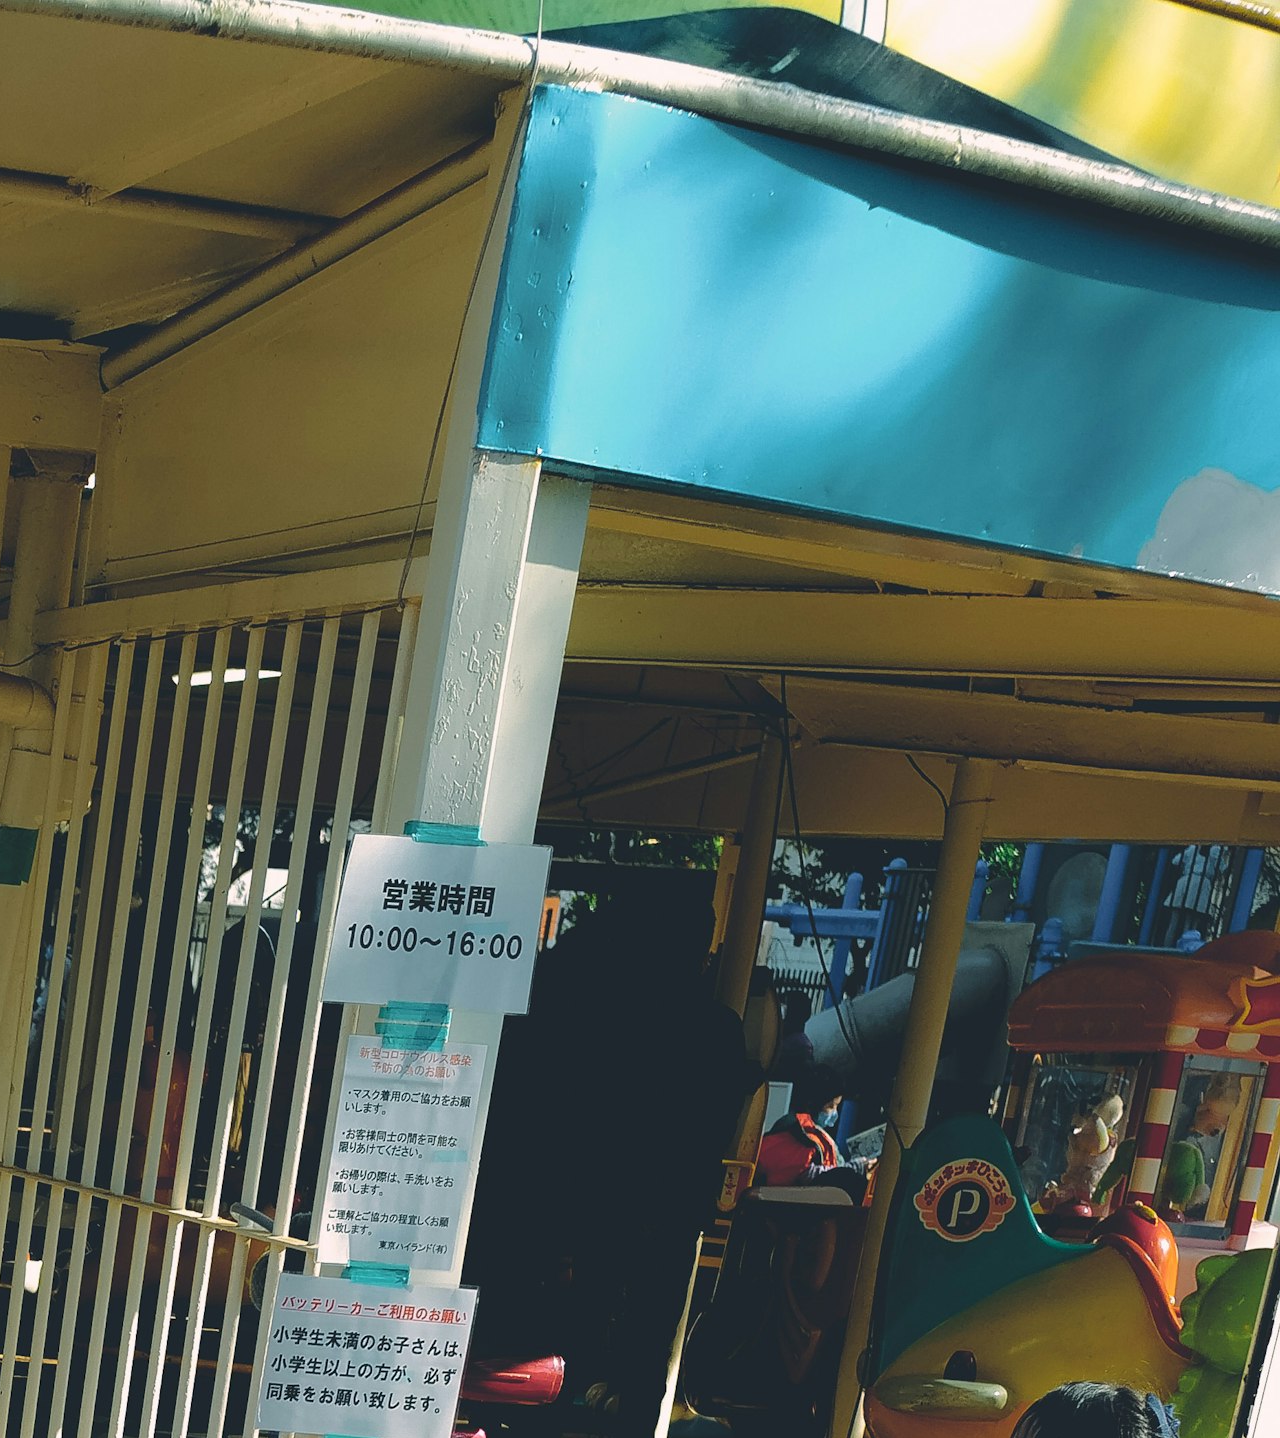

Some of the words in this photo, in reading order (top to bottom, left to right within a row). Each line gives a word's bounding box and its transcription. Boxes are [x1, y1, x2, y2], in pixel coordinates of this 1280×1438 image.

[382, 878, 496, 917] 営業時間
[360, 1046, 472, 1067] 新型コロナウイルス感染
[345, 1101, 387, 1116] いします。
[338, 1141, 423, 1159] 限りあけてください。
[331, 1181, 384, 1197] 願いします。
[327, 1209, 450, 1228] ご理解とご協力の程宜しくお願
[326, 1223, 373, 1236] い致します。
[281, 1296, 467, 1324] バッテリーカーご利用のお願い
[266, 1383, 442, 1415] 同乗をお願い致します。
